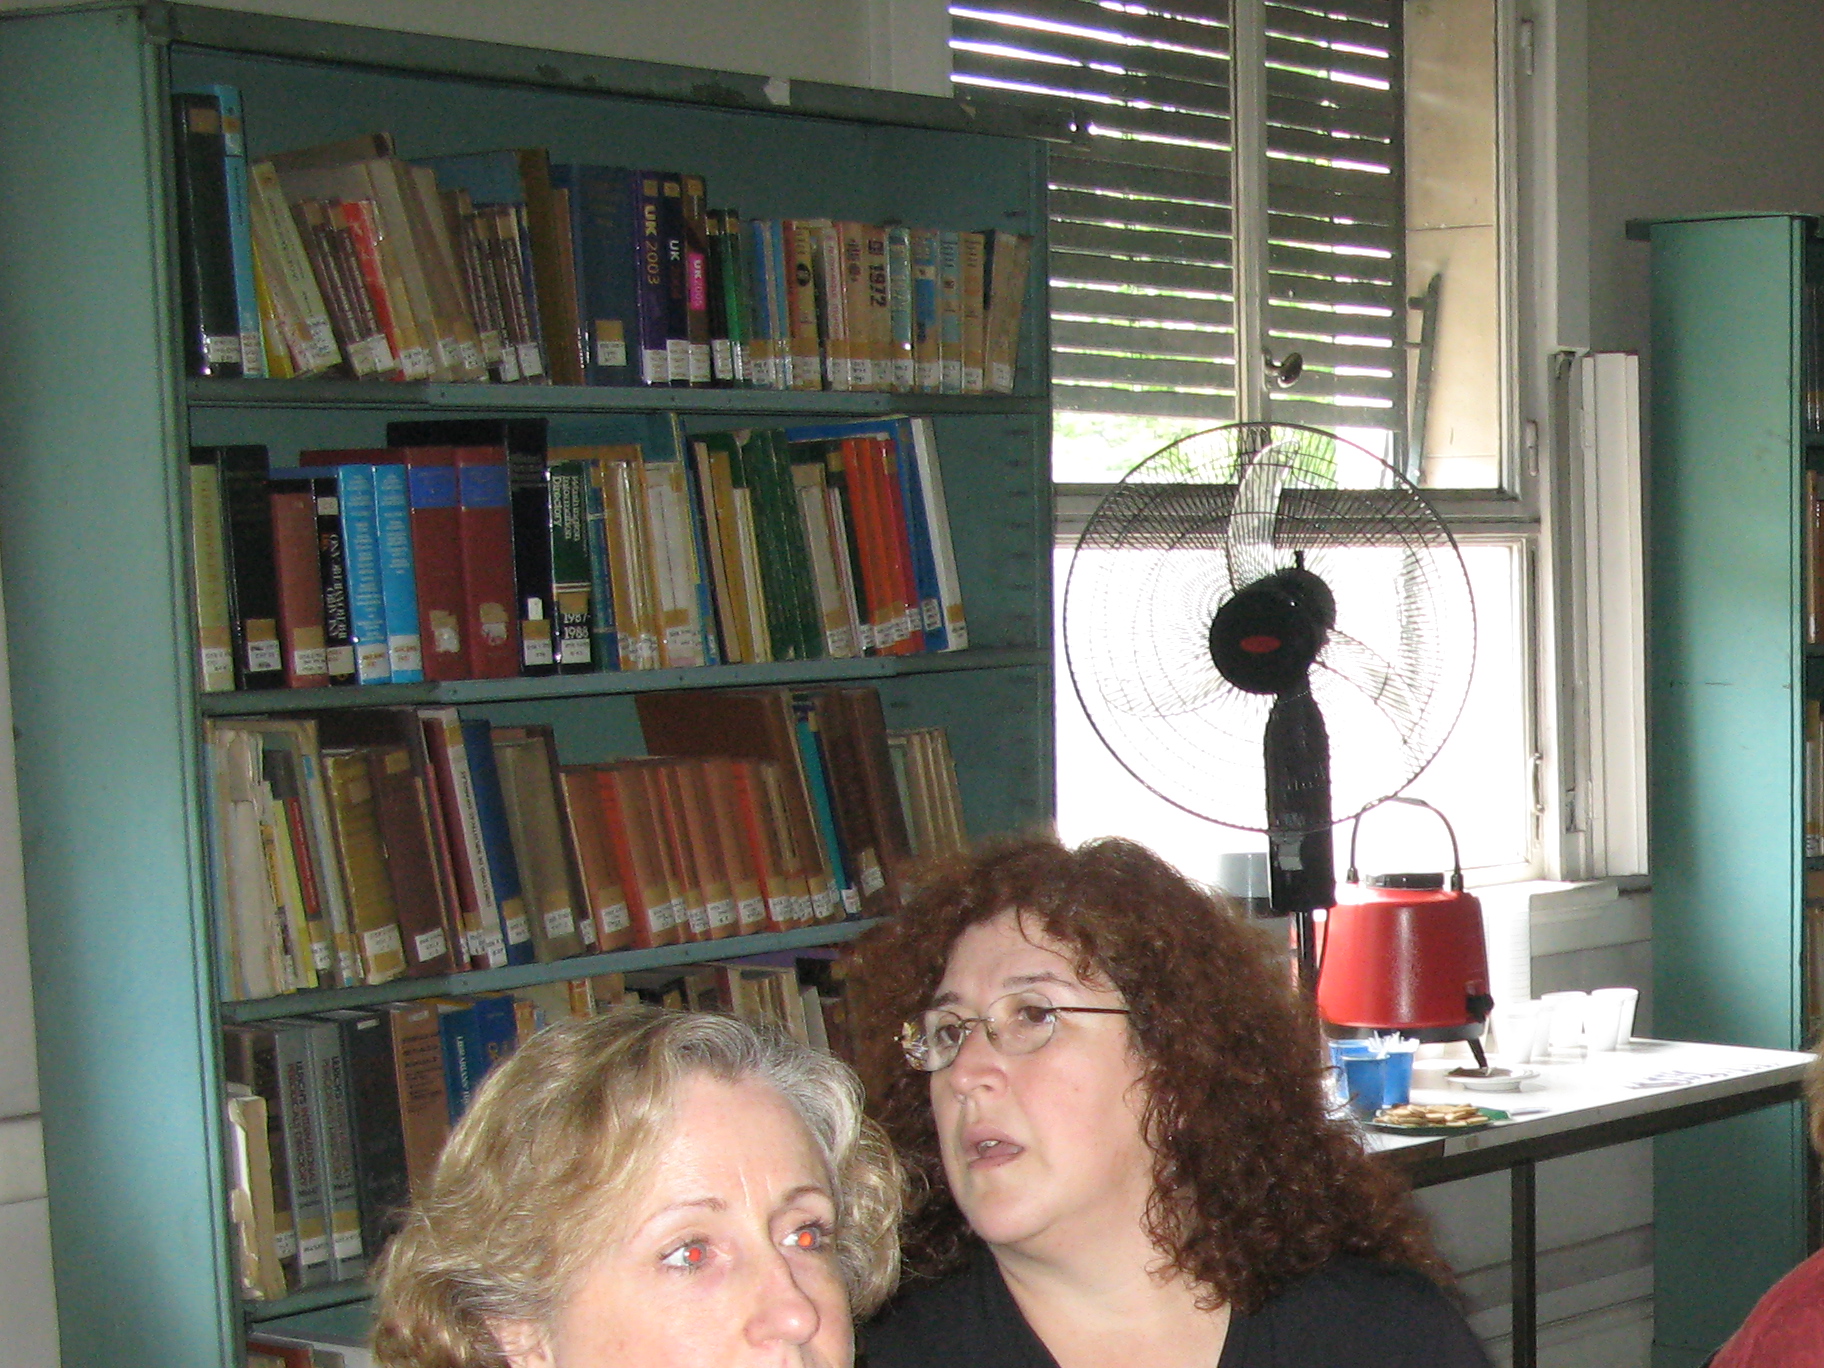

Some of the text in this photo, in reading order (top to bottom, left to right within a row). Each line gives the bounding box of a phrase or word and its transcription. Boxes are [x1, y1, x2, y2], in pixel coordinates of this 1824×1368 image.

[644, 205, 660, 284] UK 2003
[670, 240, 681, 261] UK
[693, 259, 703, 279] UK
[870, 265, 887, 307] 1972
[552, 476, 563, 527] Directory
[564, 626, 589, 639] 1988
